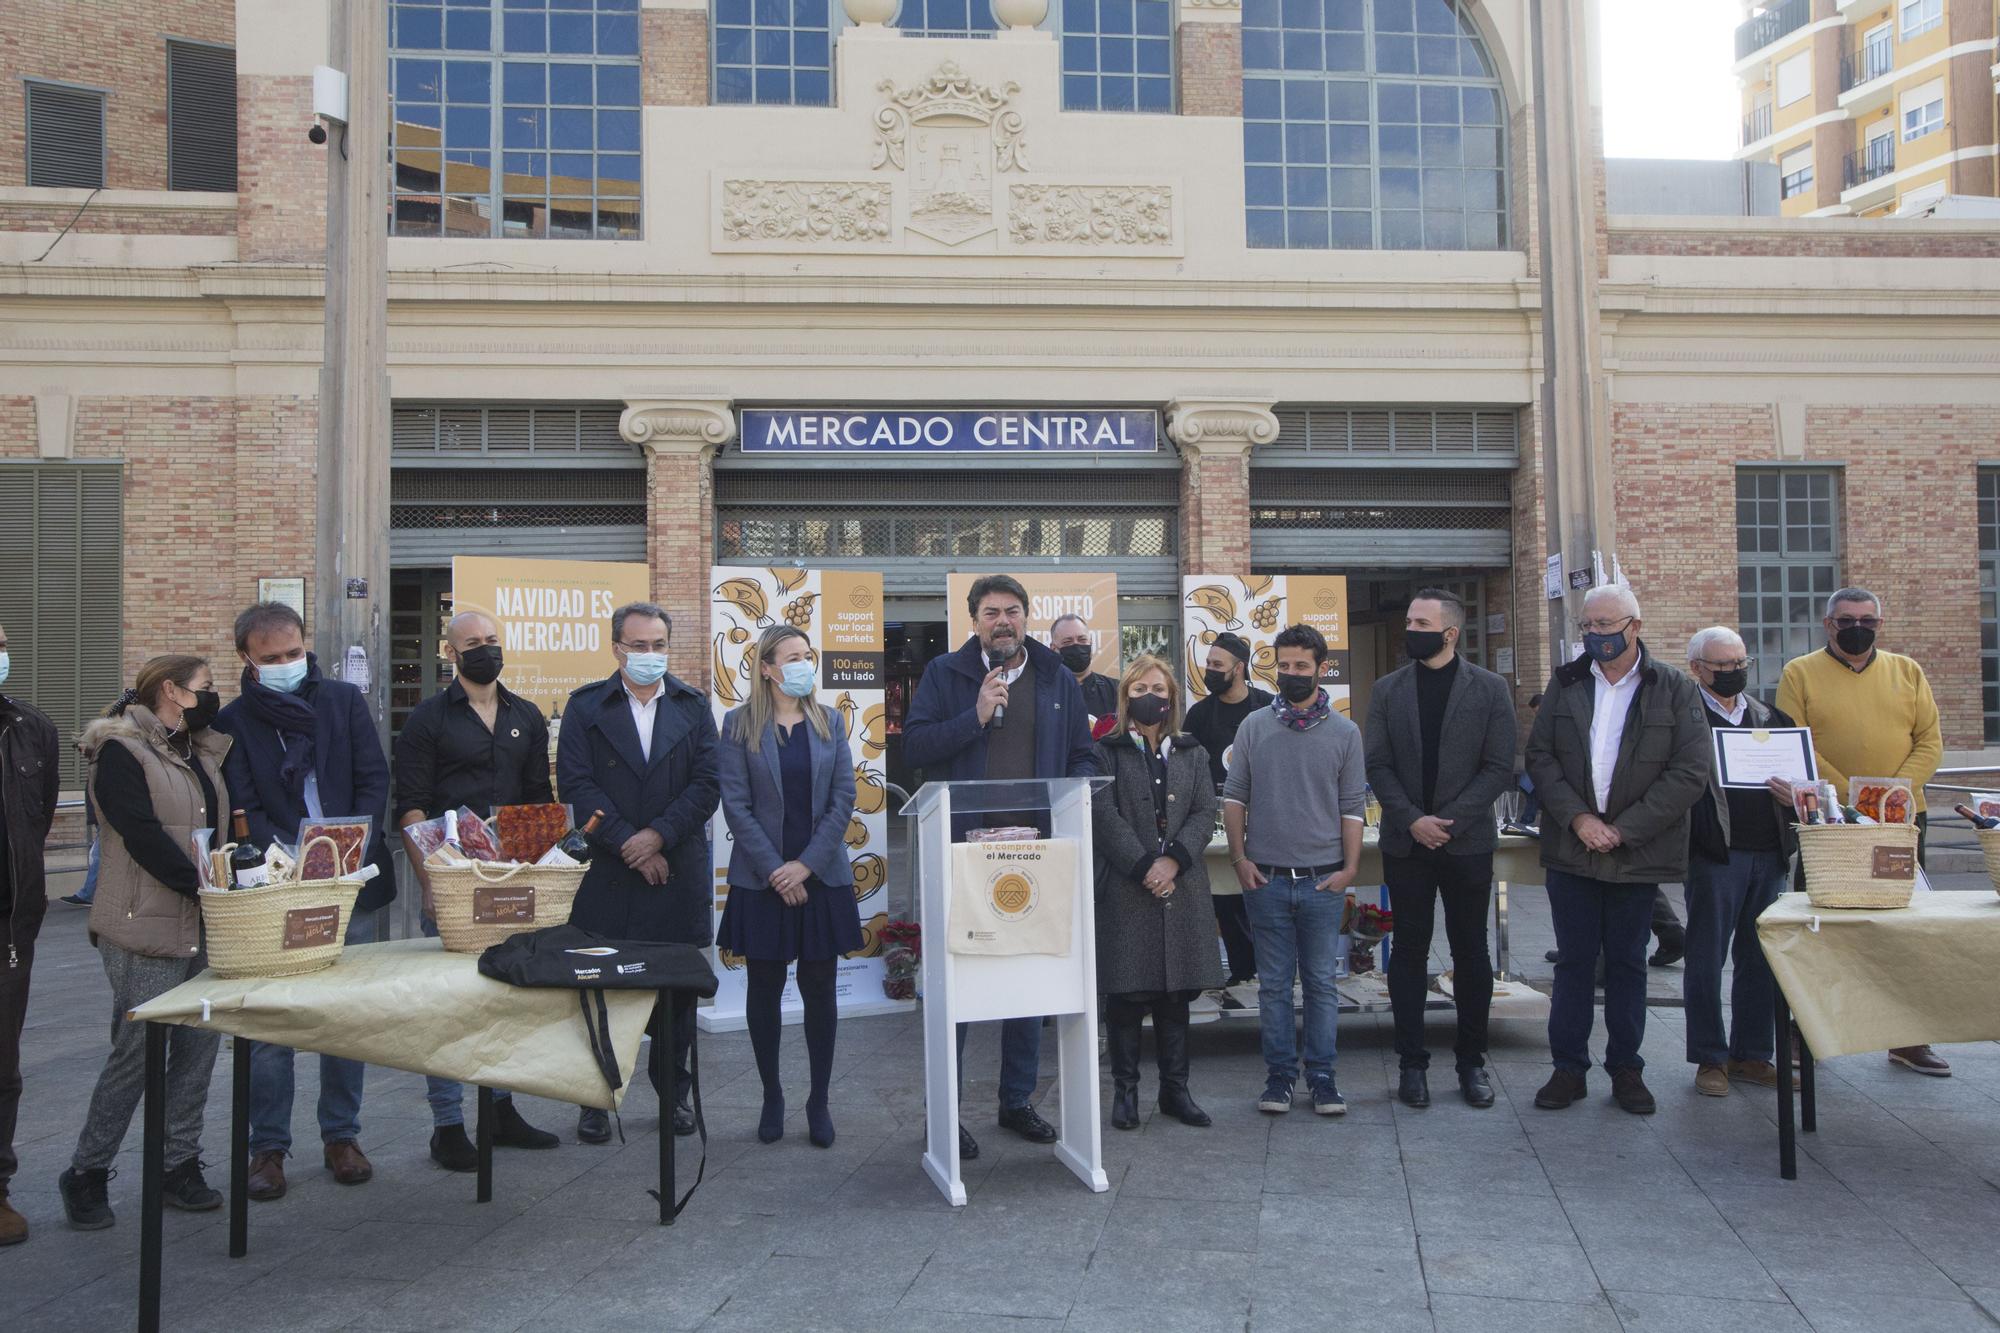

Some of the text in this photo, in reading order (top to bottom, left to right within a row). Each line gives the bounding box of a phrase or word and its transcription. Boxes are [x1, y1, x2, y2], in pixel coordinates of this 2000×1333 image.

[766, 416, 1135, 447] MERCADO CENTRAL
[496, 587, 613, 619] NAVIDAD ES
[1032, 596, 1093, 620] SORTEO
[837, 611, 874, 622] support
[1303, 613, 1338, 622] support
[828, 623, 874, 632] your local
[1316, 623, 1338, 631] local
[505, 622, 600, 652] MERCADO
[836, 634, 874, 643] markets
[832, 659, 874, 669] 100 años
[842, 673, 851, 681] tu
[854, 672, 875, 681] lado
[551, 687, 563, 695] de
[995, 843, 1032, 852] compro
[986, 852, 1041, 860] el Mercado
[574, 967, 602, 975] Mercados
